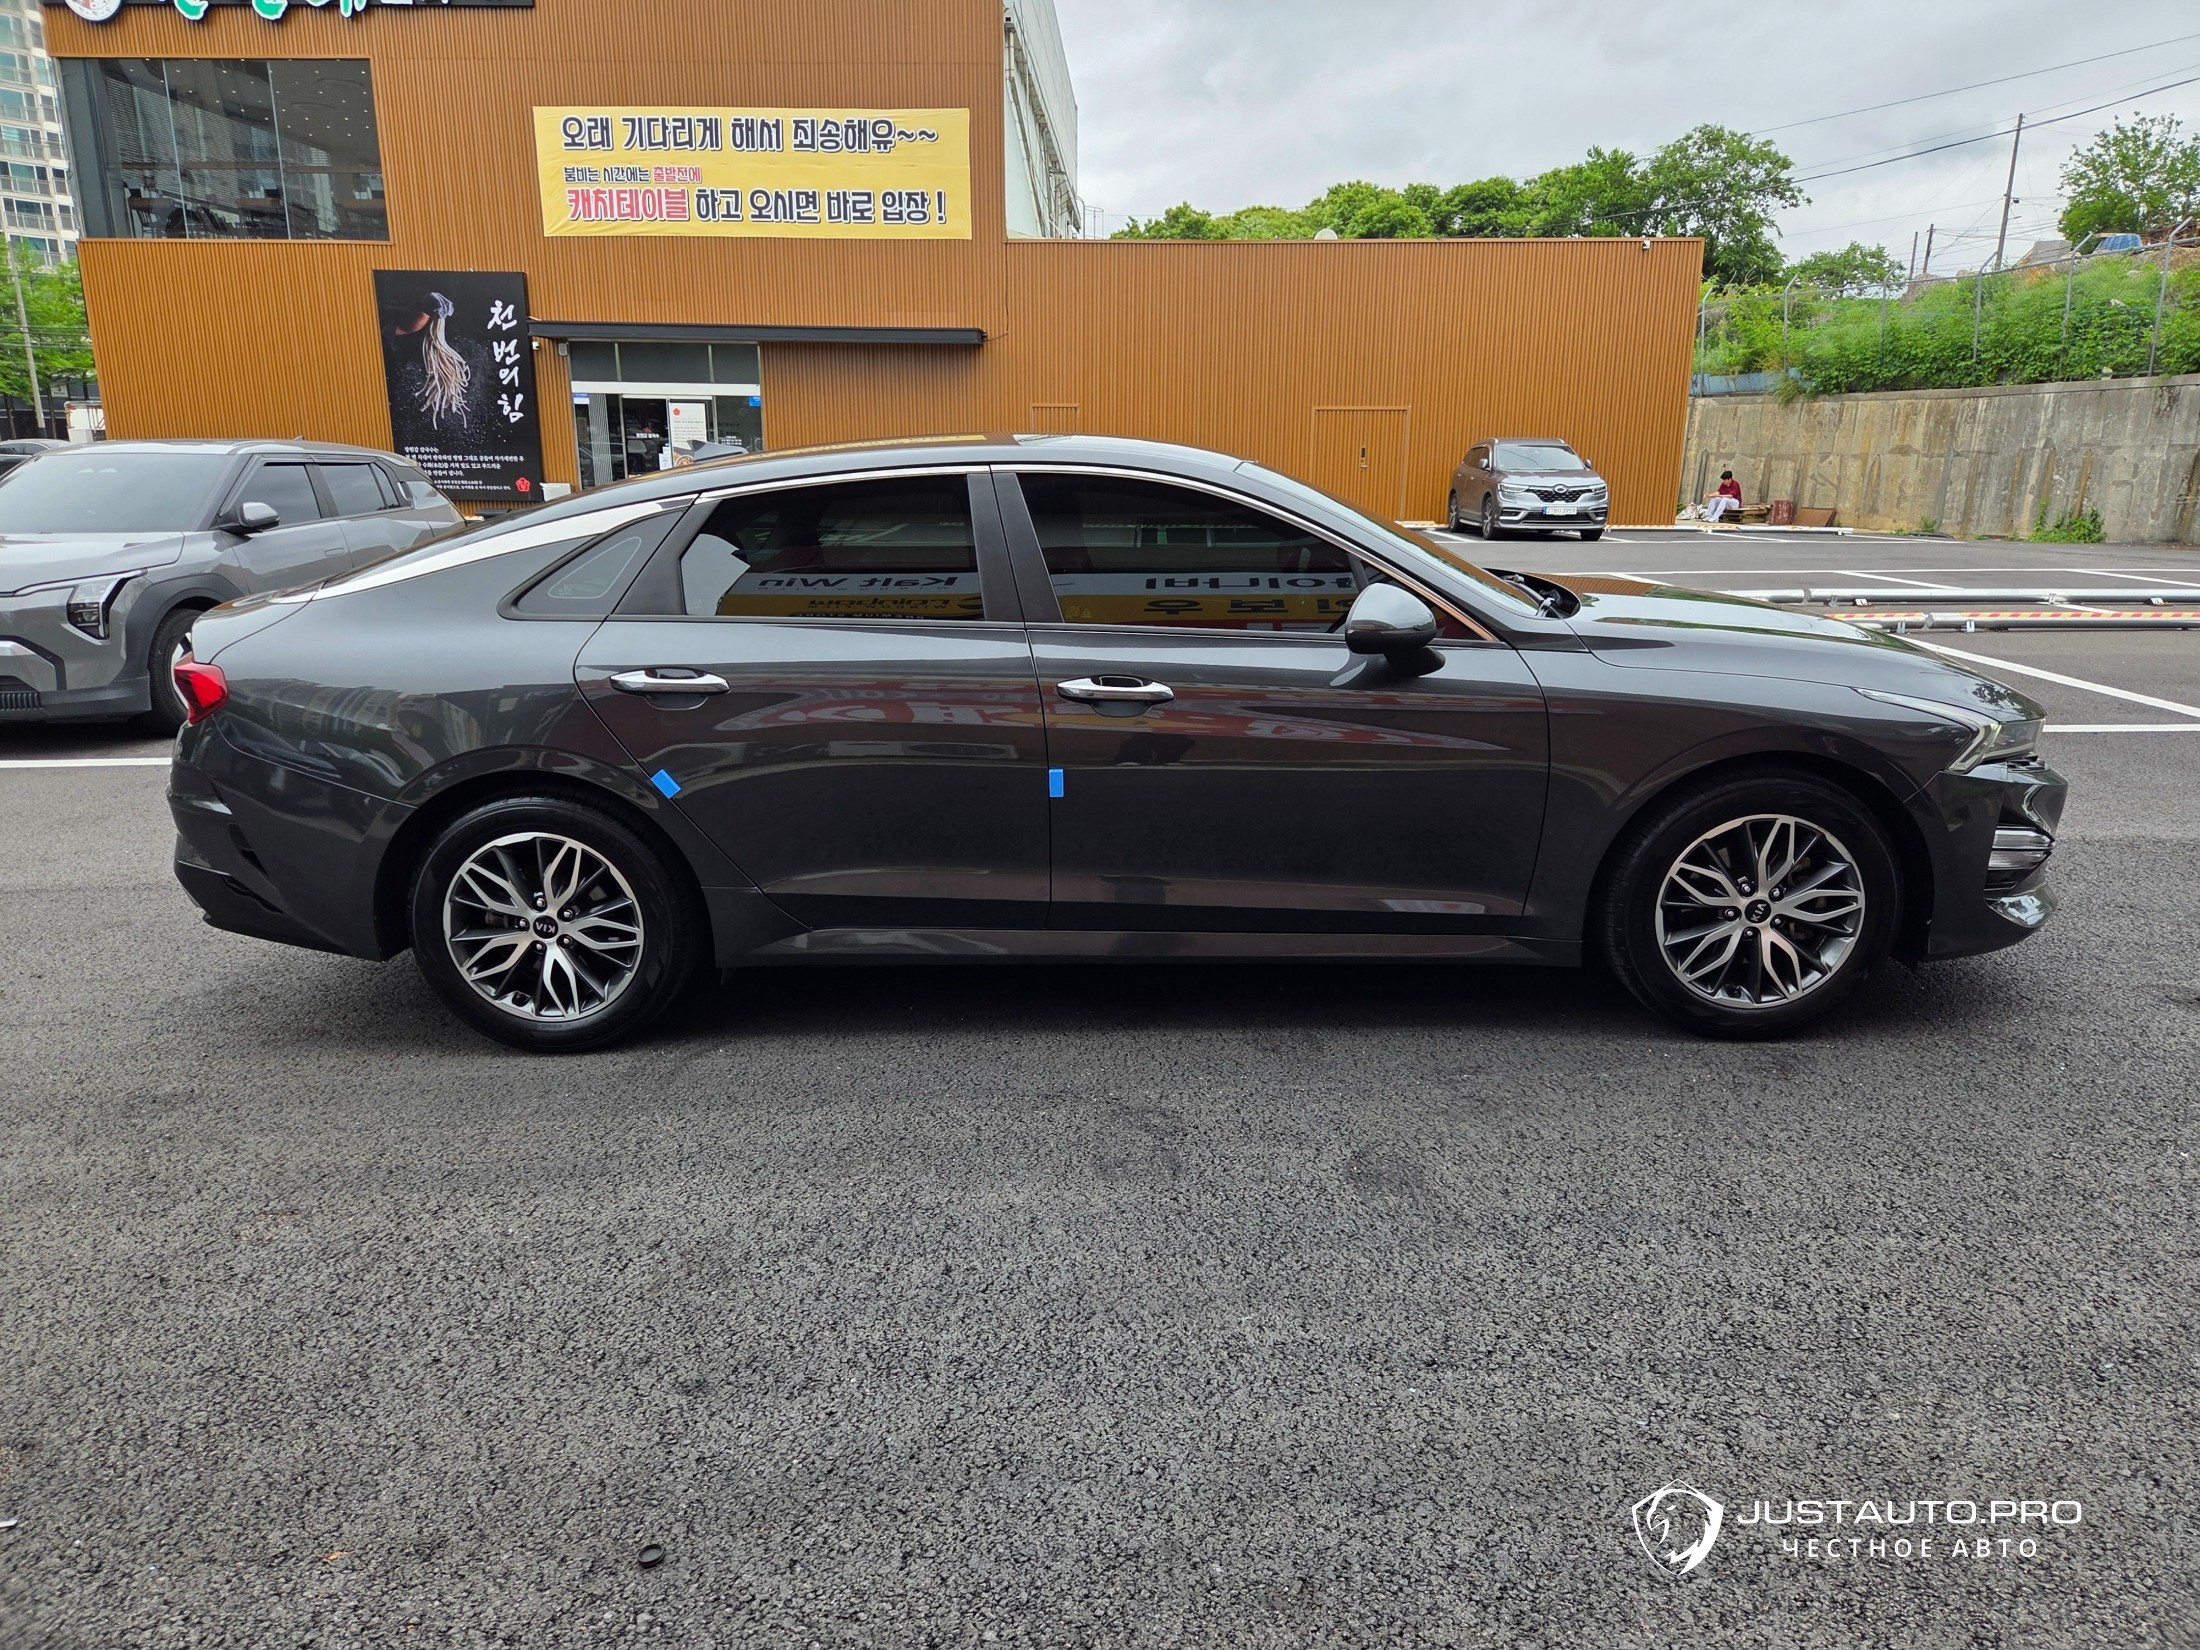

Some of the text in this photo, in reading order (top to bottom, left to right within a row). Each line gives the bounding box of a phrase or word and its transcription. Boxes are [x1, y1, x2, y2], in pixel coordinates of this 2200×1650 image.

[562, 116, 938, 153] 오래 기다리게 해서 죄송해유~~
[564, 166, 701, 183] 붐비는 시간에는 출발전에
[567, 188, 946, 223] 캐치테이블 하고 오시면 바로 입장 !
[487, 300, 517, 330] 천
[497, 393, 523, 423] 힘
[1751, 903, 1768, 921] KIA
[536, 922, 556, 933] KIA
